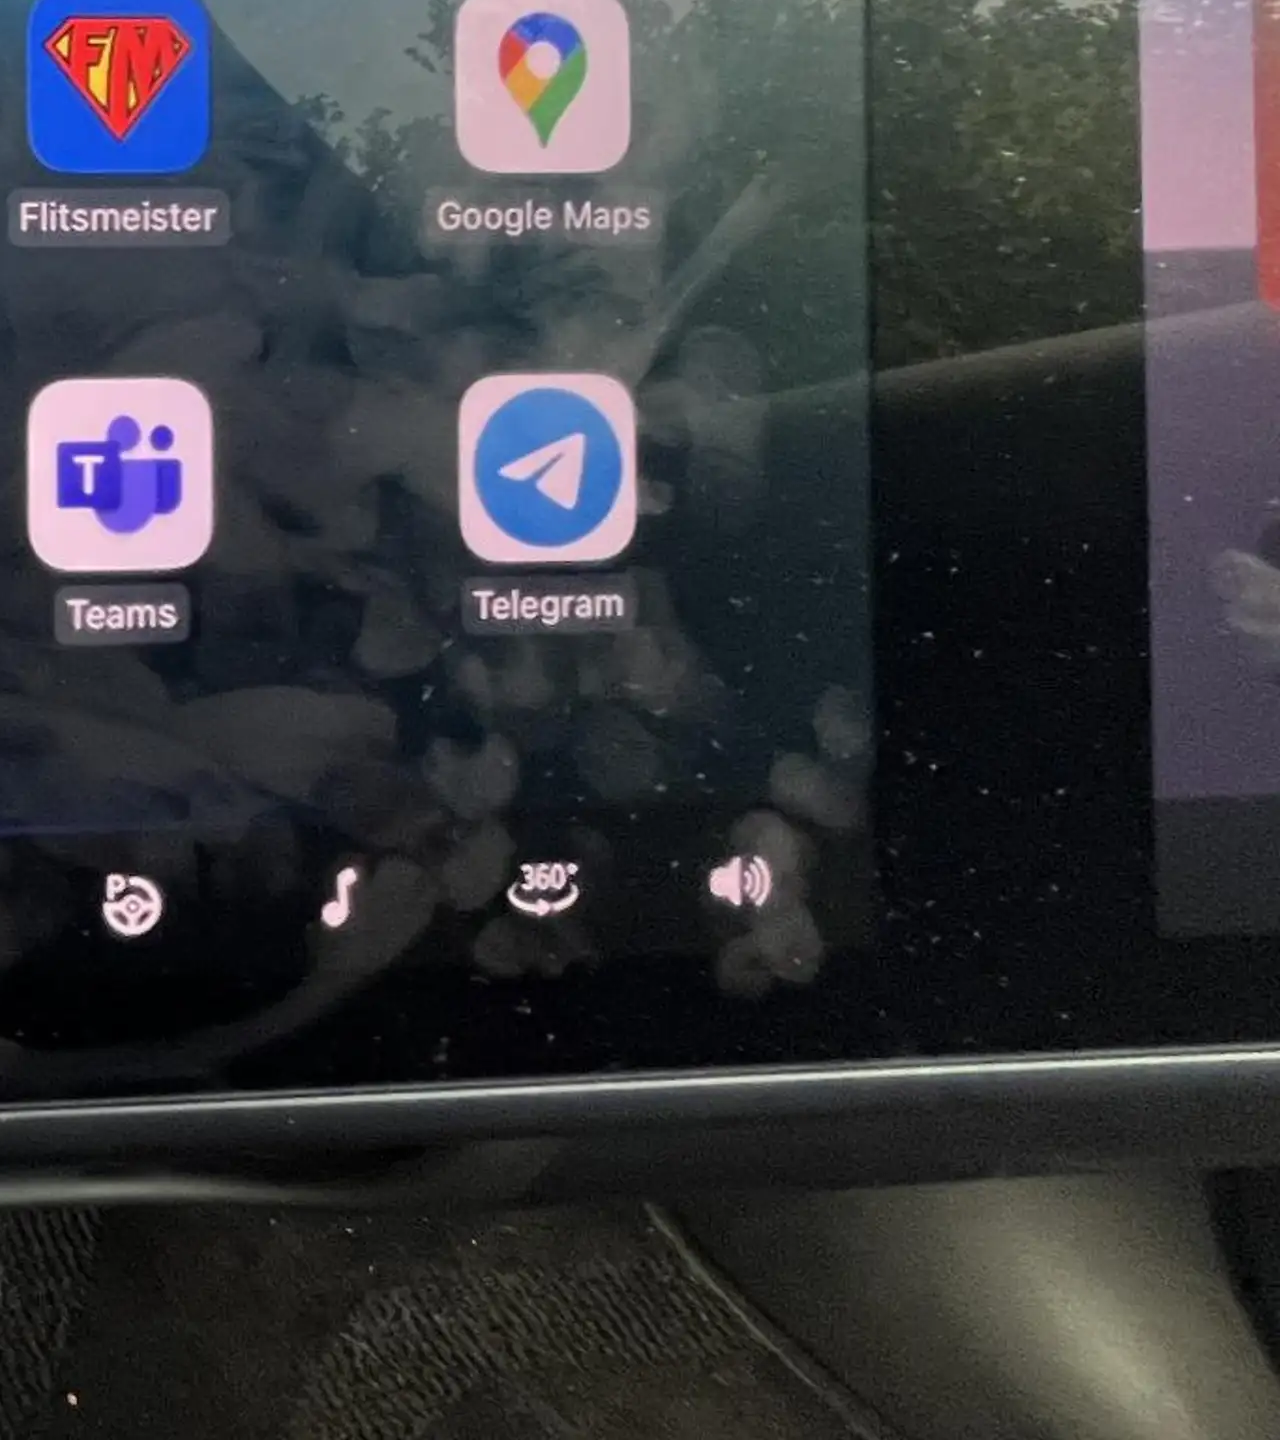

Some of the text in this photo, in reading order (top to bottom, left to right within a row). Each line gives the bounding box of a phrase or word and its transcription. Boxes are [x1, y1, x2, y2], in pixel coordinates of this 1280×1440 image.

[19, 201, 217, 233] Flitsmeister
[437, 201, 651, 237] Google Maps
[72, 455, 104, 495] T
[66, 599, 178, 630] Teams
[473, 589, 624, 625] Telegram
